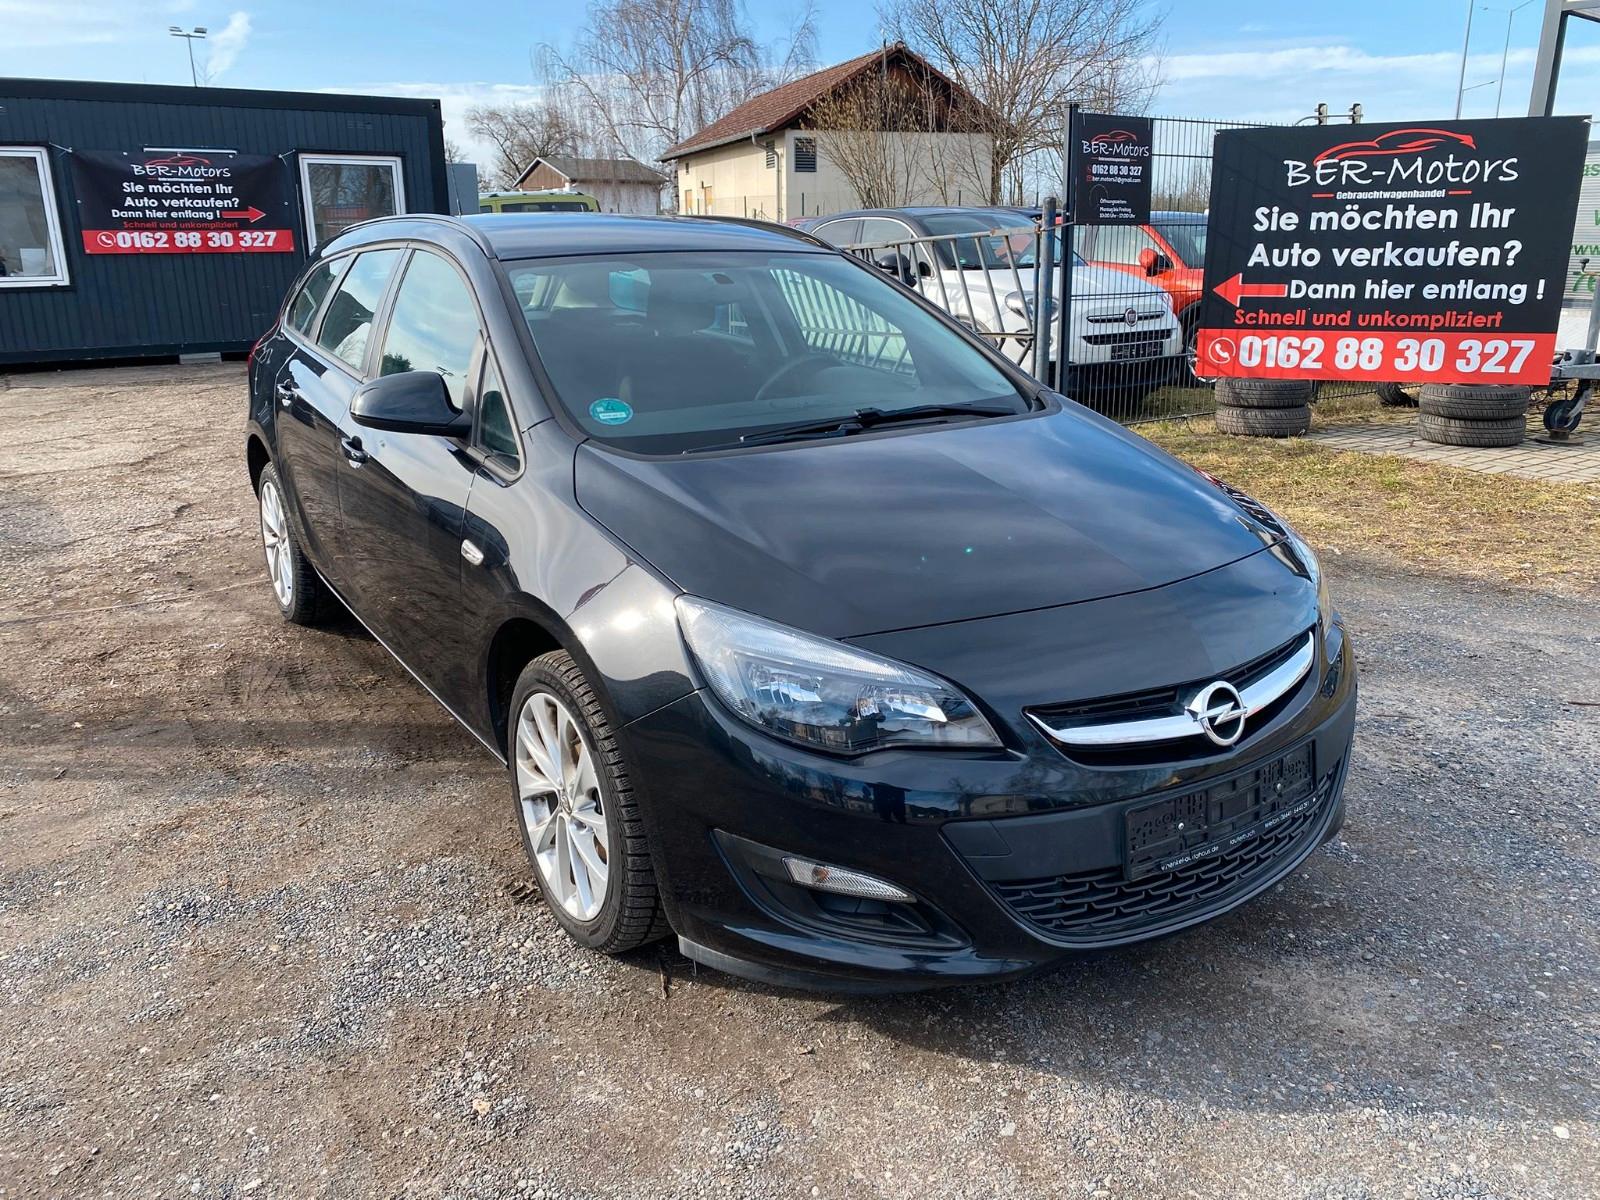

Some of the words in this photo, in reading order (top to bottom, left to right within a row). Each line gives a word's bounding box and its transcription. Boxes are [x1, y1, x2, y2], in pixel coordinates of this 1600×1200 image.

[1082, 140, 1150, 157] BER-Motors
[130, 164, 231, 178] BER-Motors
[1092, 164, 1108, 174] 0162
[1110, 165, 1118, 175] 88
[1120, 166, 1128, 175] 30
[1130, 166, 1142, 176] 327
[1283, 153, 1519, 187] BER-Motors
[122, 182, 145, 193] Sie
[148, 183, 213, 194] möchten
[215, 184, 234, 194] Ihr
[1336, 189, 1446, 200] Gebrauchtwagenhandel
[124, 196, 159, 207] Auto
[161, 197, 240, 208] verkaufen?
[111, 209, 143, 218] Dann
[145, 209, 168, 218] hier
[170, 209, 214, 220] entlang
[1252, 206, 1299, 232] Sie
[1309, 203, 1458, 231] möchten
[1469, 202, 1516, 229] Ihr
[123, 221, 157, 229] Schnell
[159, 221, 177, 229] und
[179, 221, 239, 230] unkompliziert
[116, 231, 170, 248] 0162
[174, 231, 202, 248] 88
[207, 231, 234, 248] 30
[238, 231, 277, 247] 327
[1247, 242, 1321, 267] Auto
[1332, 239, 1523, 267] verkaufen?
[1290, 279, 1356, 299] Dann
[1364, 278, 1416, 299] hier
[1422, 278, 1528, 305] entlang
[1536, 278, 1546, 300] !
[1234, 309, 1306, 325] Schnell
[1312, 310, 1352, 326] und
[1357, 310, 1503, 330] unkompliziert
[1238, 335, 1325, 369] 0162
[1334, 337, 1384, 371] 88
[1394, 338, 1446, 372] 30
[1455, 339, 1536, 374] 327
